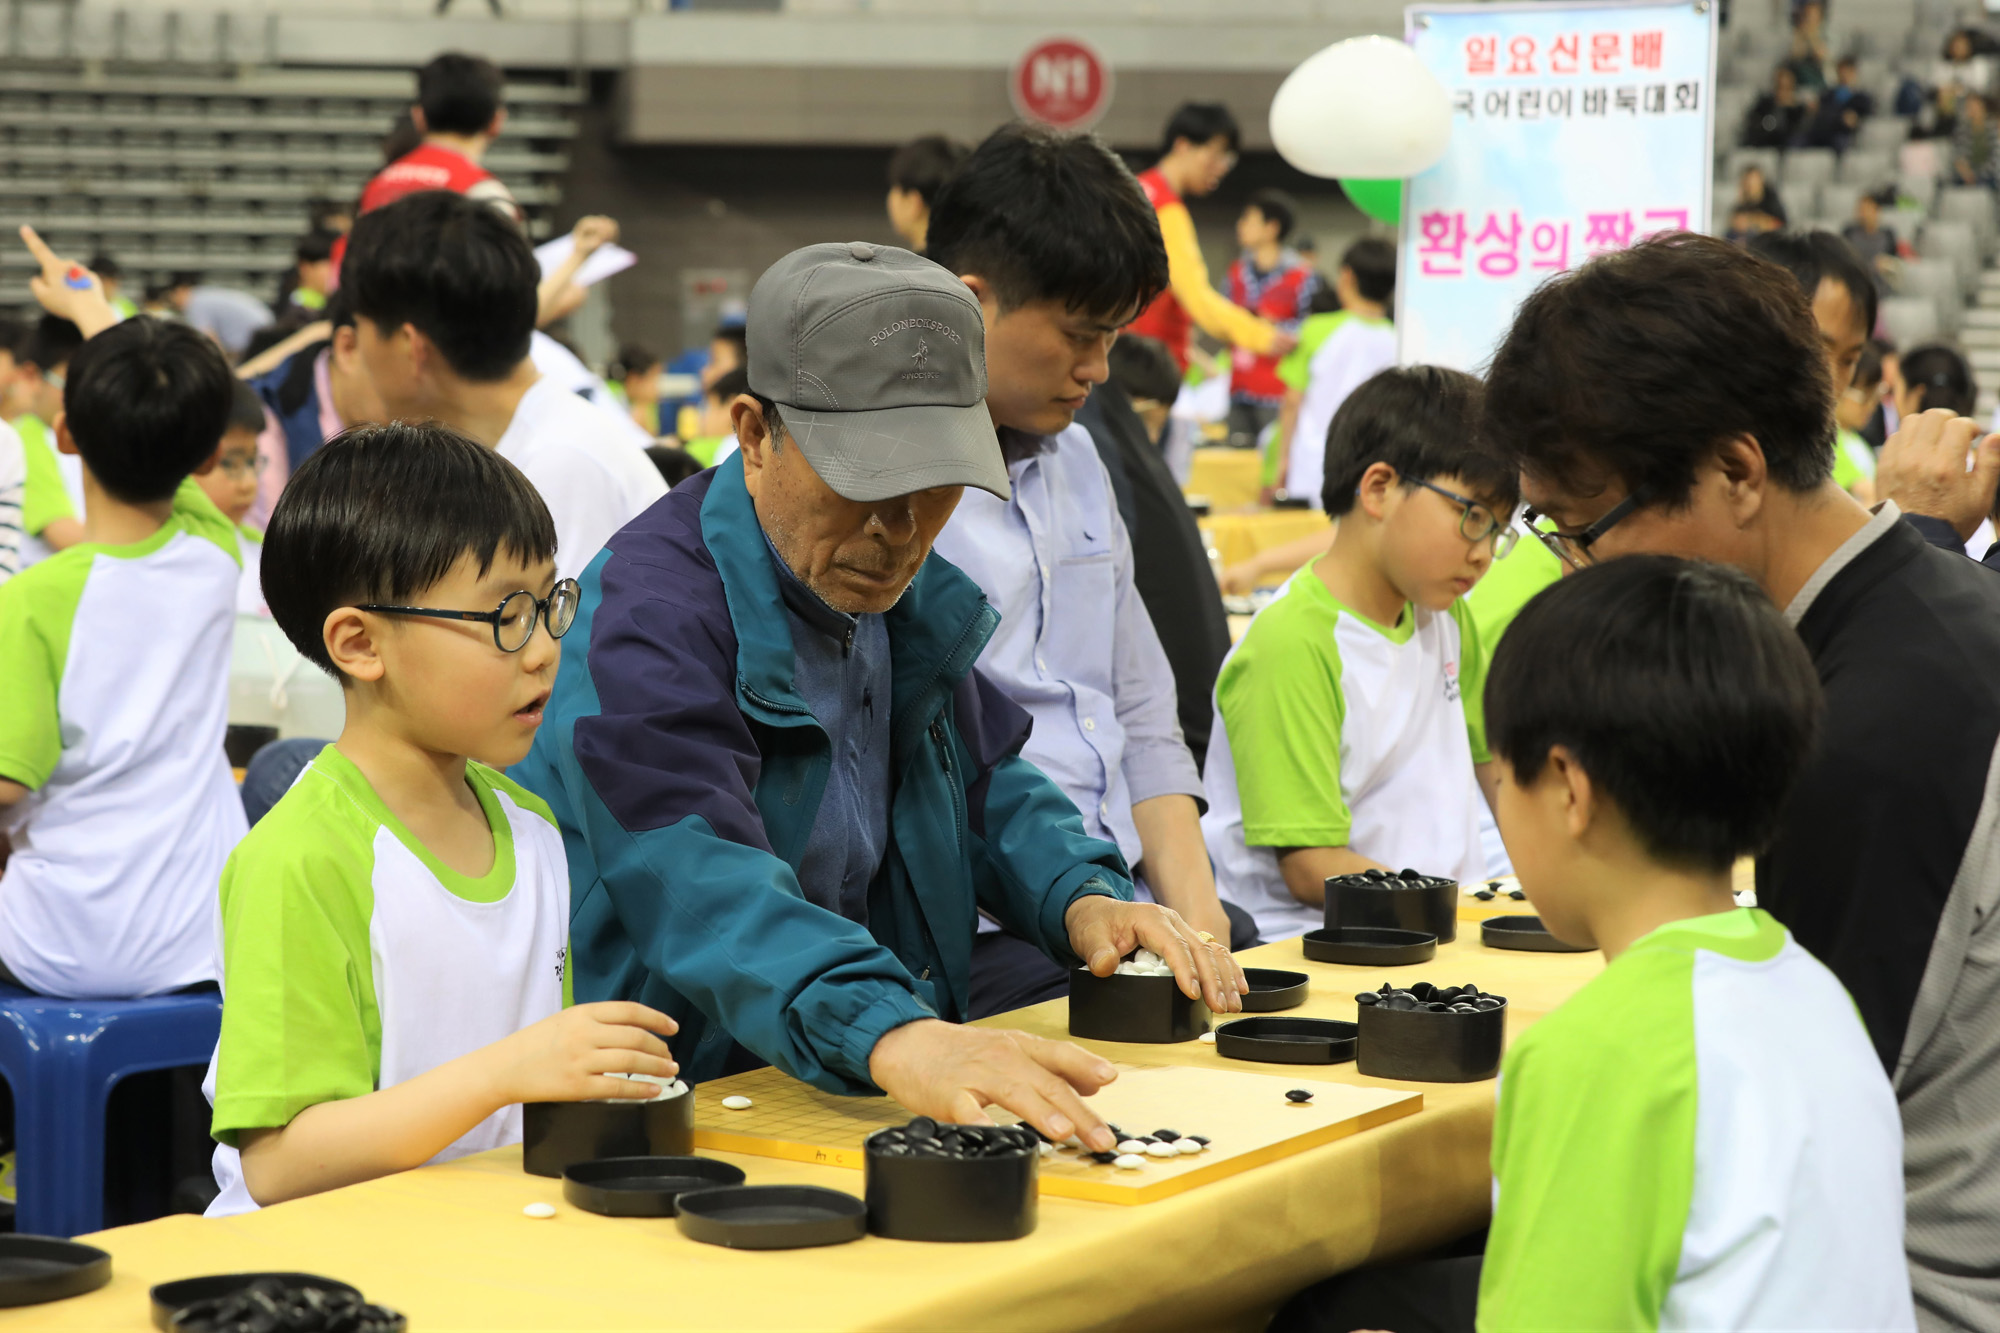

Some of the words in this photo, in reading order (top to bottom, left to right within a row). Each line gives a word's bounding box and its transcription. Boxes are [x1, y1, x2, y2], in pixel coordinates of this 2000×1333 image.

[1466, 31, 1662, 74] 일요신문배
[1031, 55, 1088, 98] N1
[1418, 209, 1570, 277] 환상의
